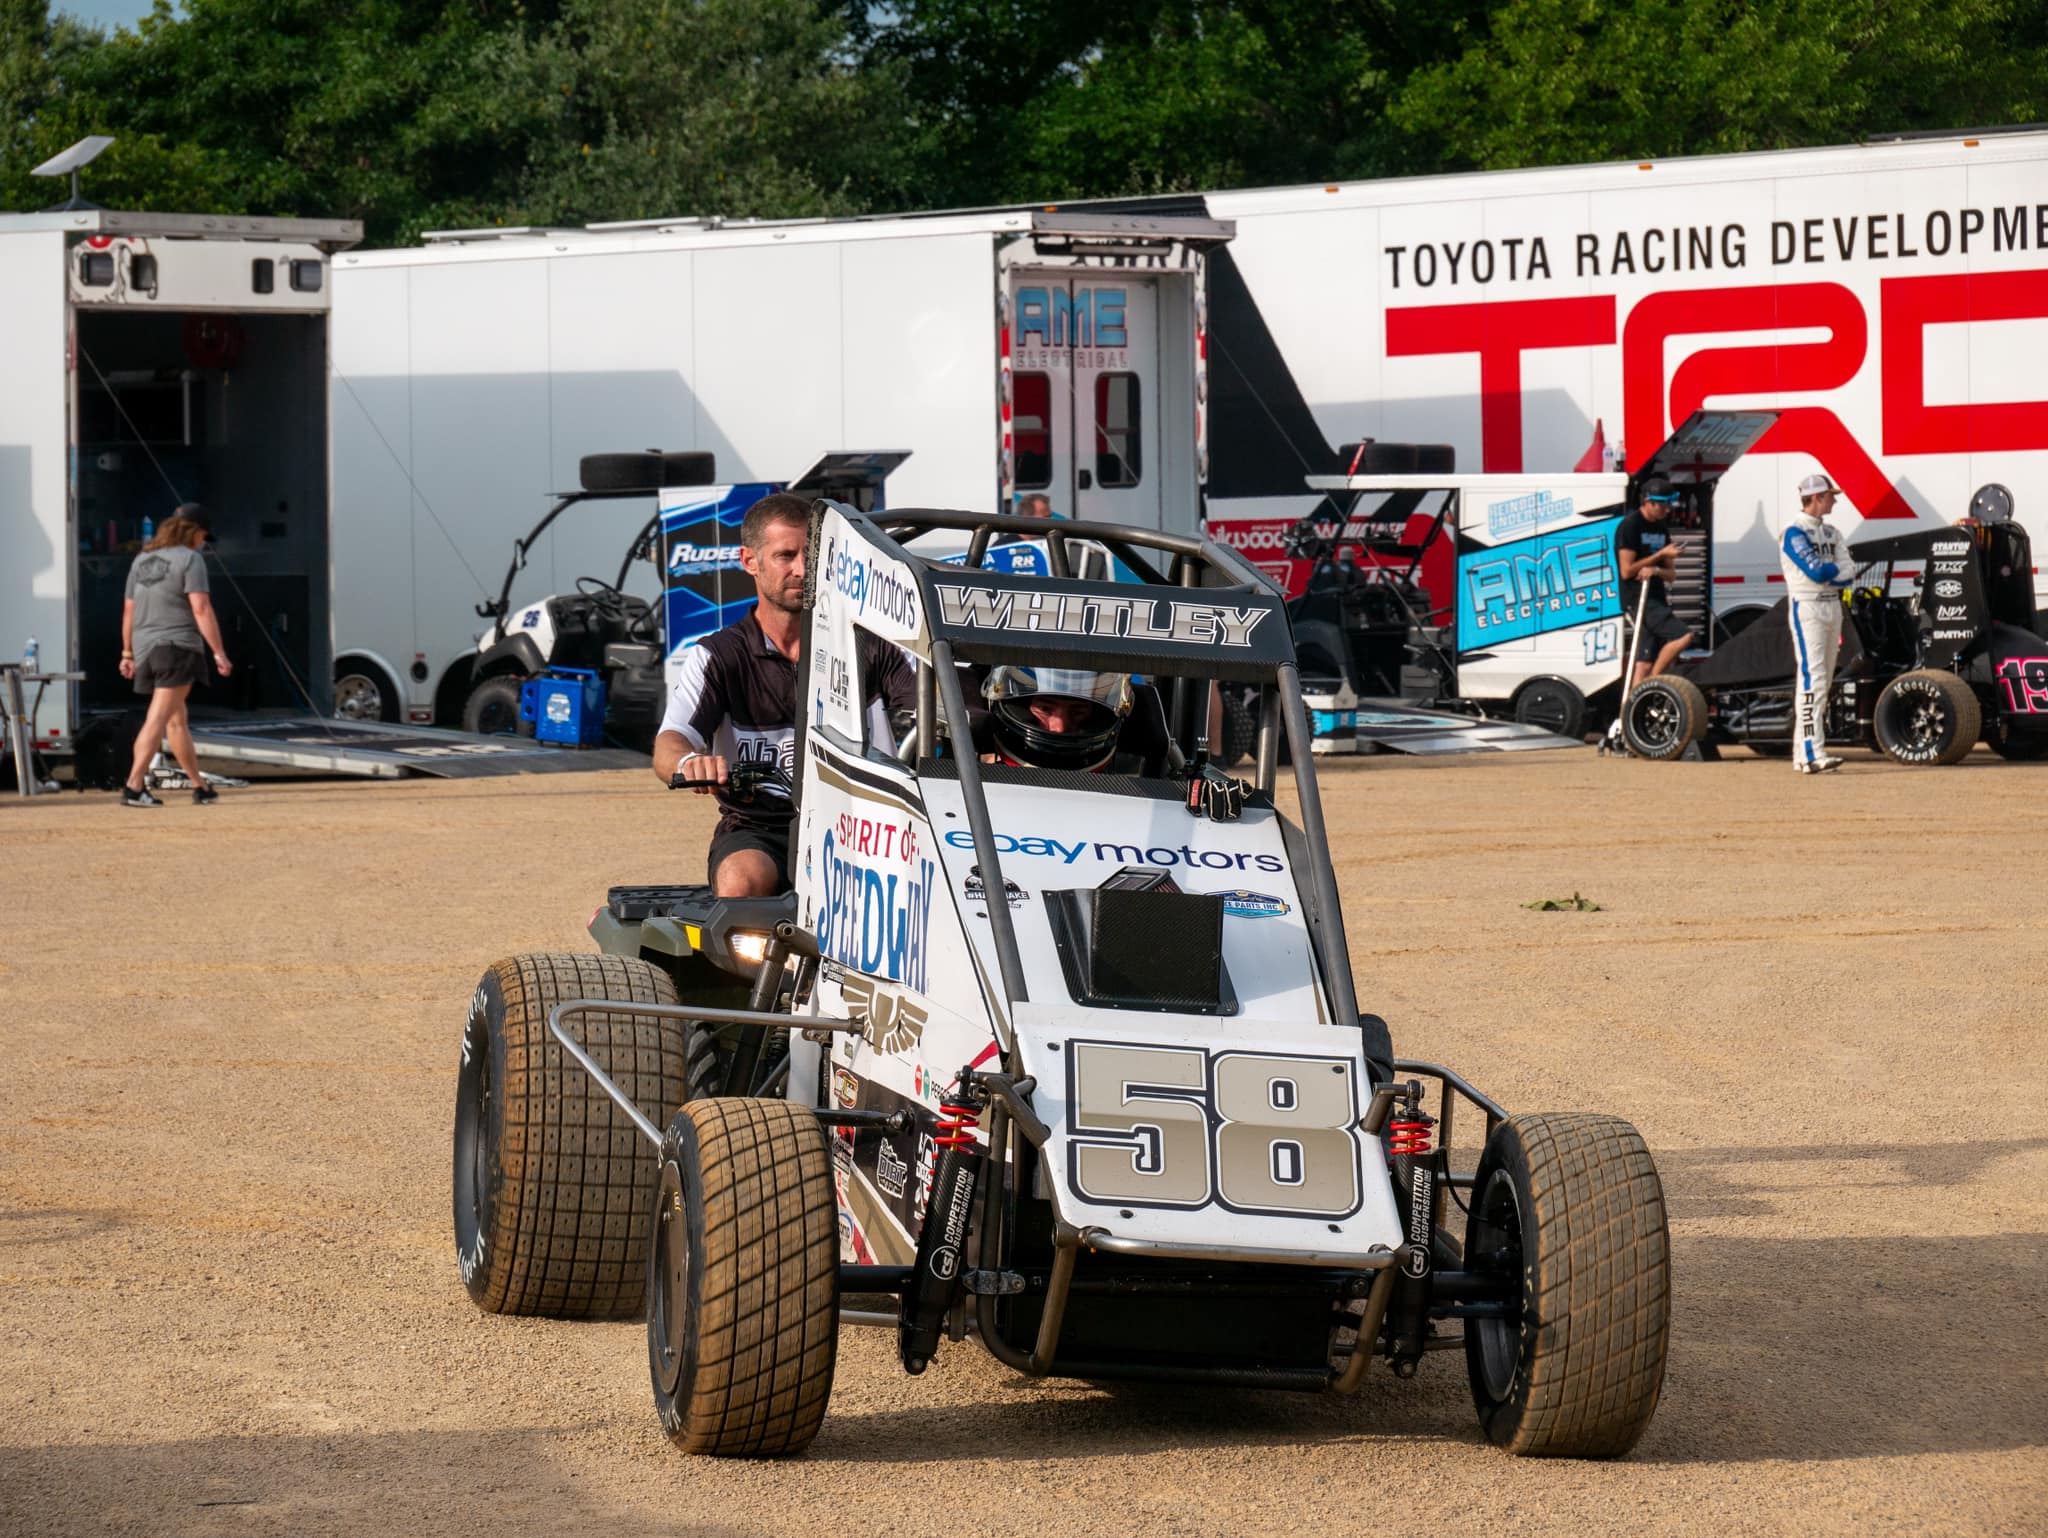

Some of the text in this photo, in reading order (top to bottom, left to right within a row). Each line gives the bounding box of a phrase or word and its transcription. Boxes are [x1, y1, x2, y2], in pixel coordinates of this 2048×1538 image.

[1385, 236, 1552, 288] TOYOTA
[1575, 222, 1747, 277] RACING
[1016, 286, 1128, 349] AME
[837, 539, 873, 617] ebay
[869, 567, 917, 631] motors
[1467, 535, 1615, 614] AME
[1477, 586, 1617, 629] ELECTRICAL
[934, 584, 1272, 647] WHITLEY
[1583, 623, 1618, 666] 19
[839, 813, 917, 865] SPIRIT OF
[1093, 842, 1285, 873] motors
[817, 828, 935, 995] SPEEDWAY
[1065, 1038, 1365, 1221] 58
[944, 1166, 968, 1244] COMPETITION
[953, 1182, 972, 1248] SUSPENSION
[1411, 1166, 1424, 1242] COMPETITION
[1421, 1182, 1432, 1246] SUSPENSION
